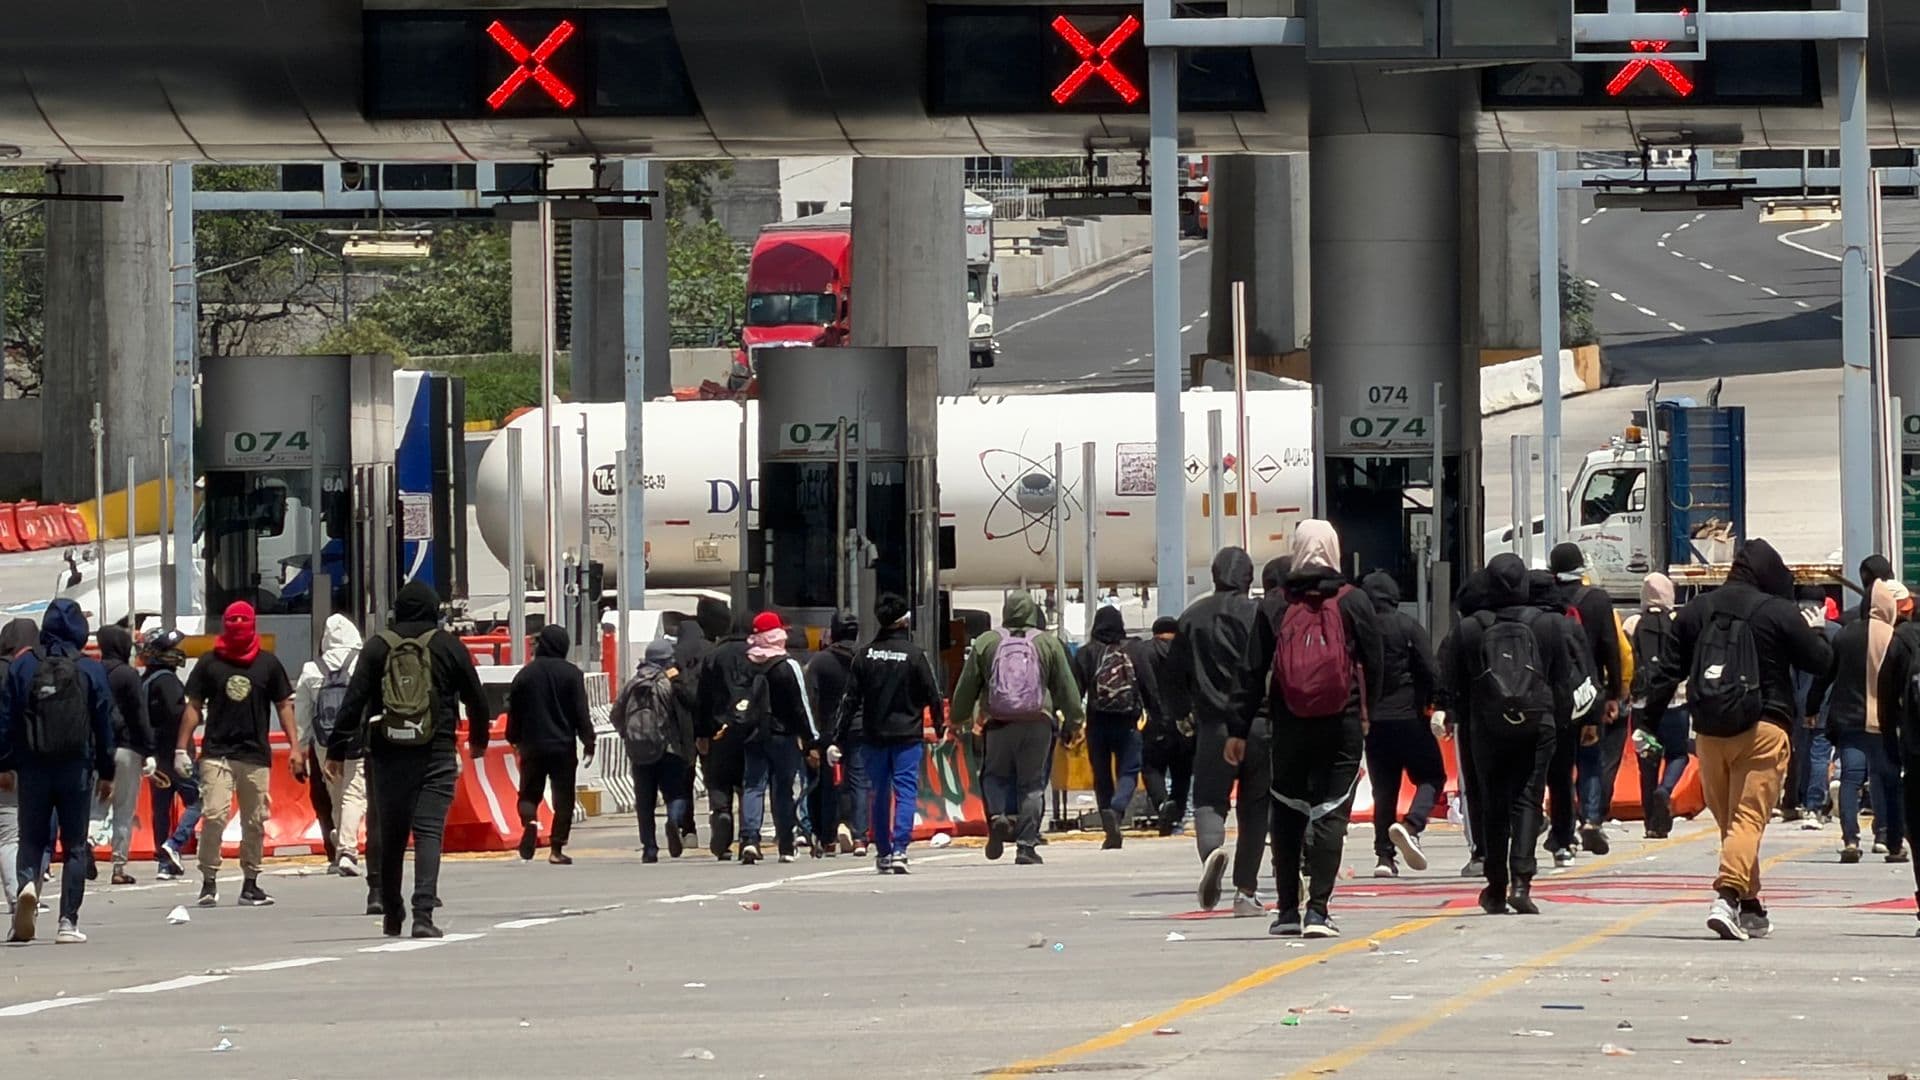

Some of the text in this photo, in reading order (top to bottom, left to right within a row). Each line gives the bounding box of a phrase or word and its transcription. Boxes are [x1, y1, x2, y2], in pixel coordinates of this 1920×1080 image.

[1368, 386, 1408, 403] 074
[1350, 417, 1426, 437] 074
[234, 431, 310, 452] 074
